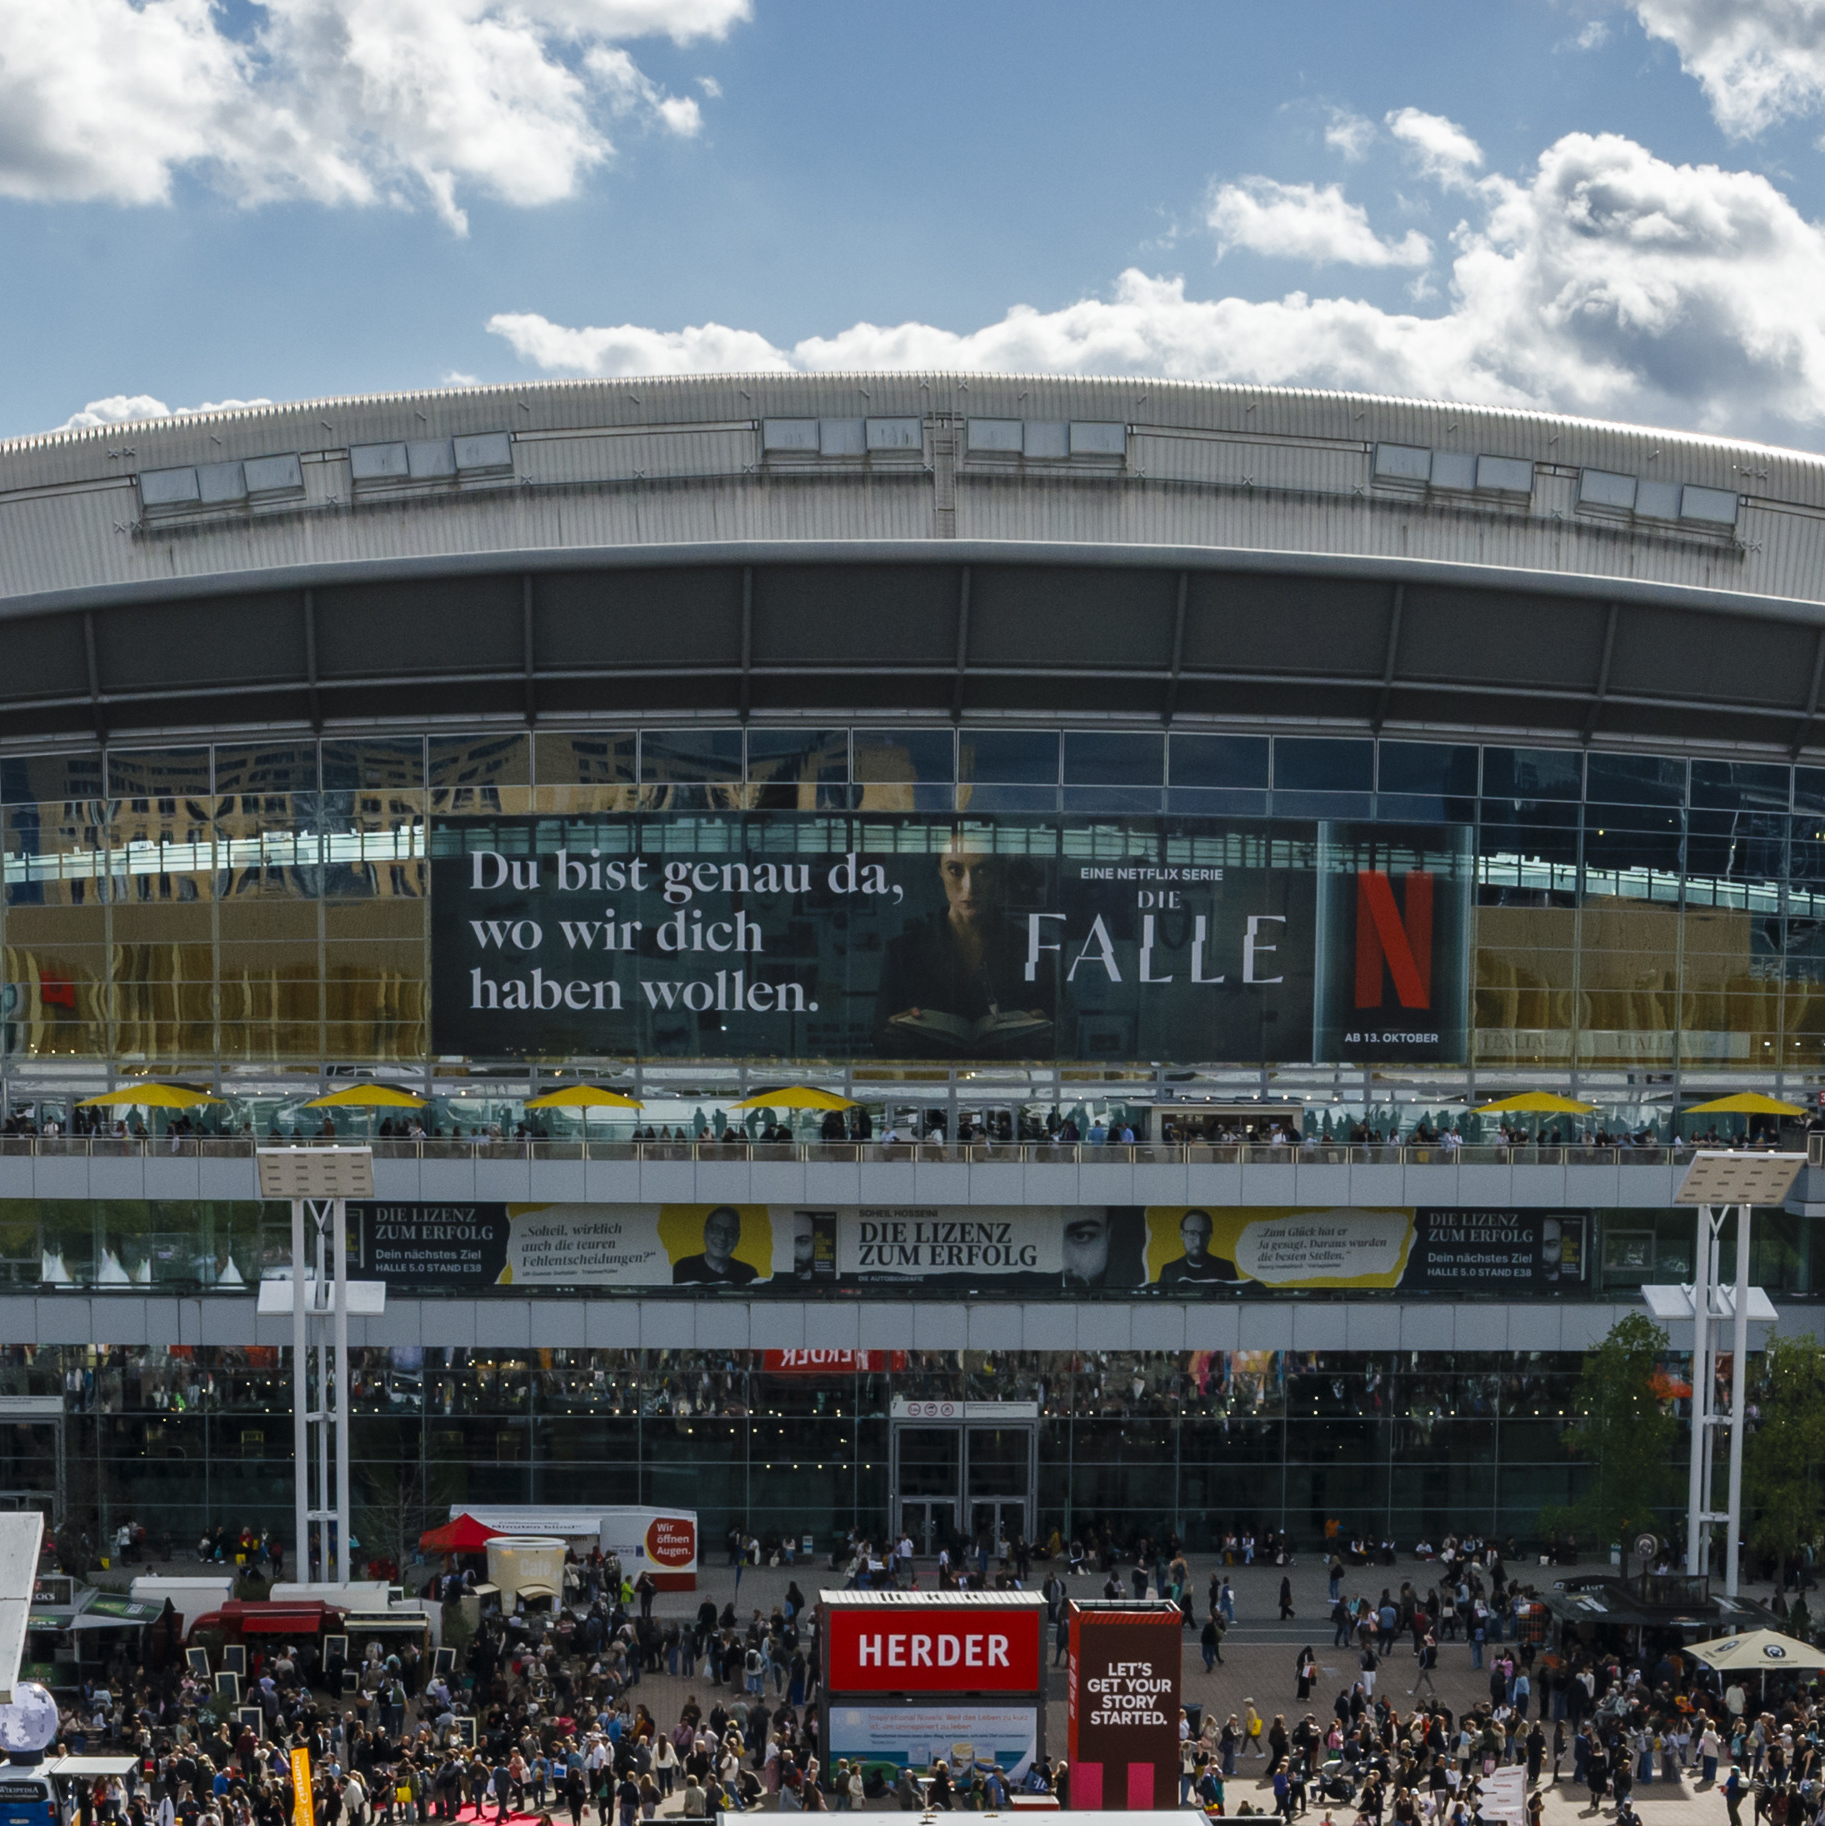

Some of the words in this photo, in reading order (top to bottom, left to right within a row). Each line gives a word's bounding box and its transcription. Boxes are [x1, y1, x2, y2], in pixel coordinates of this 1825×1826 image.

[470, 850, 540, 891] Du
[556, 848, 648, 891] bist
[663, 861, 811, 904] genau
[828, 853, 904, 904] da,
[1080, 867, 1114, 881] EINE
[1117, 867, 1179, 881] NETFLIX
[1182, 868, 1223, 881] SERIE
[1138, 890, 1181, 909] DIE
[470, 919, 543, 951] wo
[559, 908, 642, 951] wir
[656, 910, 765, 952] dich
[1355, 870, 1433, 1010] N
[1024, 912, 1286, 984] FALLE
[470, 967, 624, 1010] haben
[641, 970, 819, 1012] wollen.
[1344, 1032, 1361, 1044] AB
[1364, 1032, 1380, 1044] 13.
[1382, 1033, 1439, 1044] OKTOBER
[375, 1207, 408, 1222] DIE
[411, 1208, 476, 1223] LIZENZ
[1428, 1213, 1457, 1226] DIE
[1461, 1213, 1519, 1227] LIZENZ
[375, 1224, 418, 1240] ZUM
[422, 1225, 494, 1241] ERFOLG
[572, 1222, 622, 1235] wirklich
[859, 1222, 908, 1244] DIE
[915, 1222, 1012, 1244] LIZENZ
[1428, 1228, 1465, 1242] ZUM
[1469, 1229, 1534, 1243] ERFOLG
[521, 1240, 552, 1252] auch
[554, 1239, 574, 1251] die
[1349, 1238, 1387, 1248] wurden
[375, 1250, 398, 1261] Dein
[403, 1249, 458, 1261] nächstes
[461, 1250, 482, 1261] Ziel
[858, 1245, 922, 1266] ZUM
[929, 1245, 1039, 1267] ERFOLG
[1427, 1252, 1453, 1263] Dein
[1455, 1252, 1509, 1264] nächstes
[1511, 1252, 1533, 1264] Ziel
[375, 1263, 407, 1273] HALLE
[409, 1263, 425, 1273] 5.0
[427, 1263, 462, 1273] STAND
[1427, 1267, 1459, 1277] HALLE
[1460, 1267, 1476, 1277] 5.0
[1478, 1268, 1512, 1277] STAND
[657, 1523, 674, 1532] Wir
[656, 1534, 690, 1544] öffnen
[656, 1546, 691, 1556] Augen.
[858, 1634, 1011, 1667] HERDER
[1087, 1678, 1121, 1693] GET
[1126, 1678, 1172, 1694] YOUR
[1102, 1695, 1157, 1710] STORY
[1090, 1711, 1168, 1726] STARTED.
